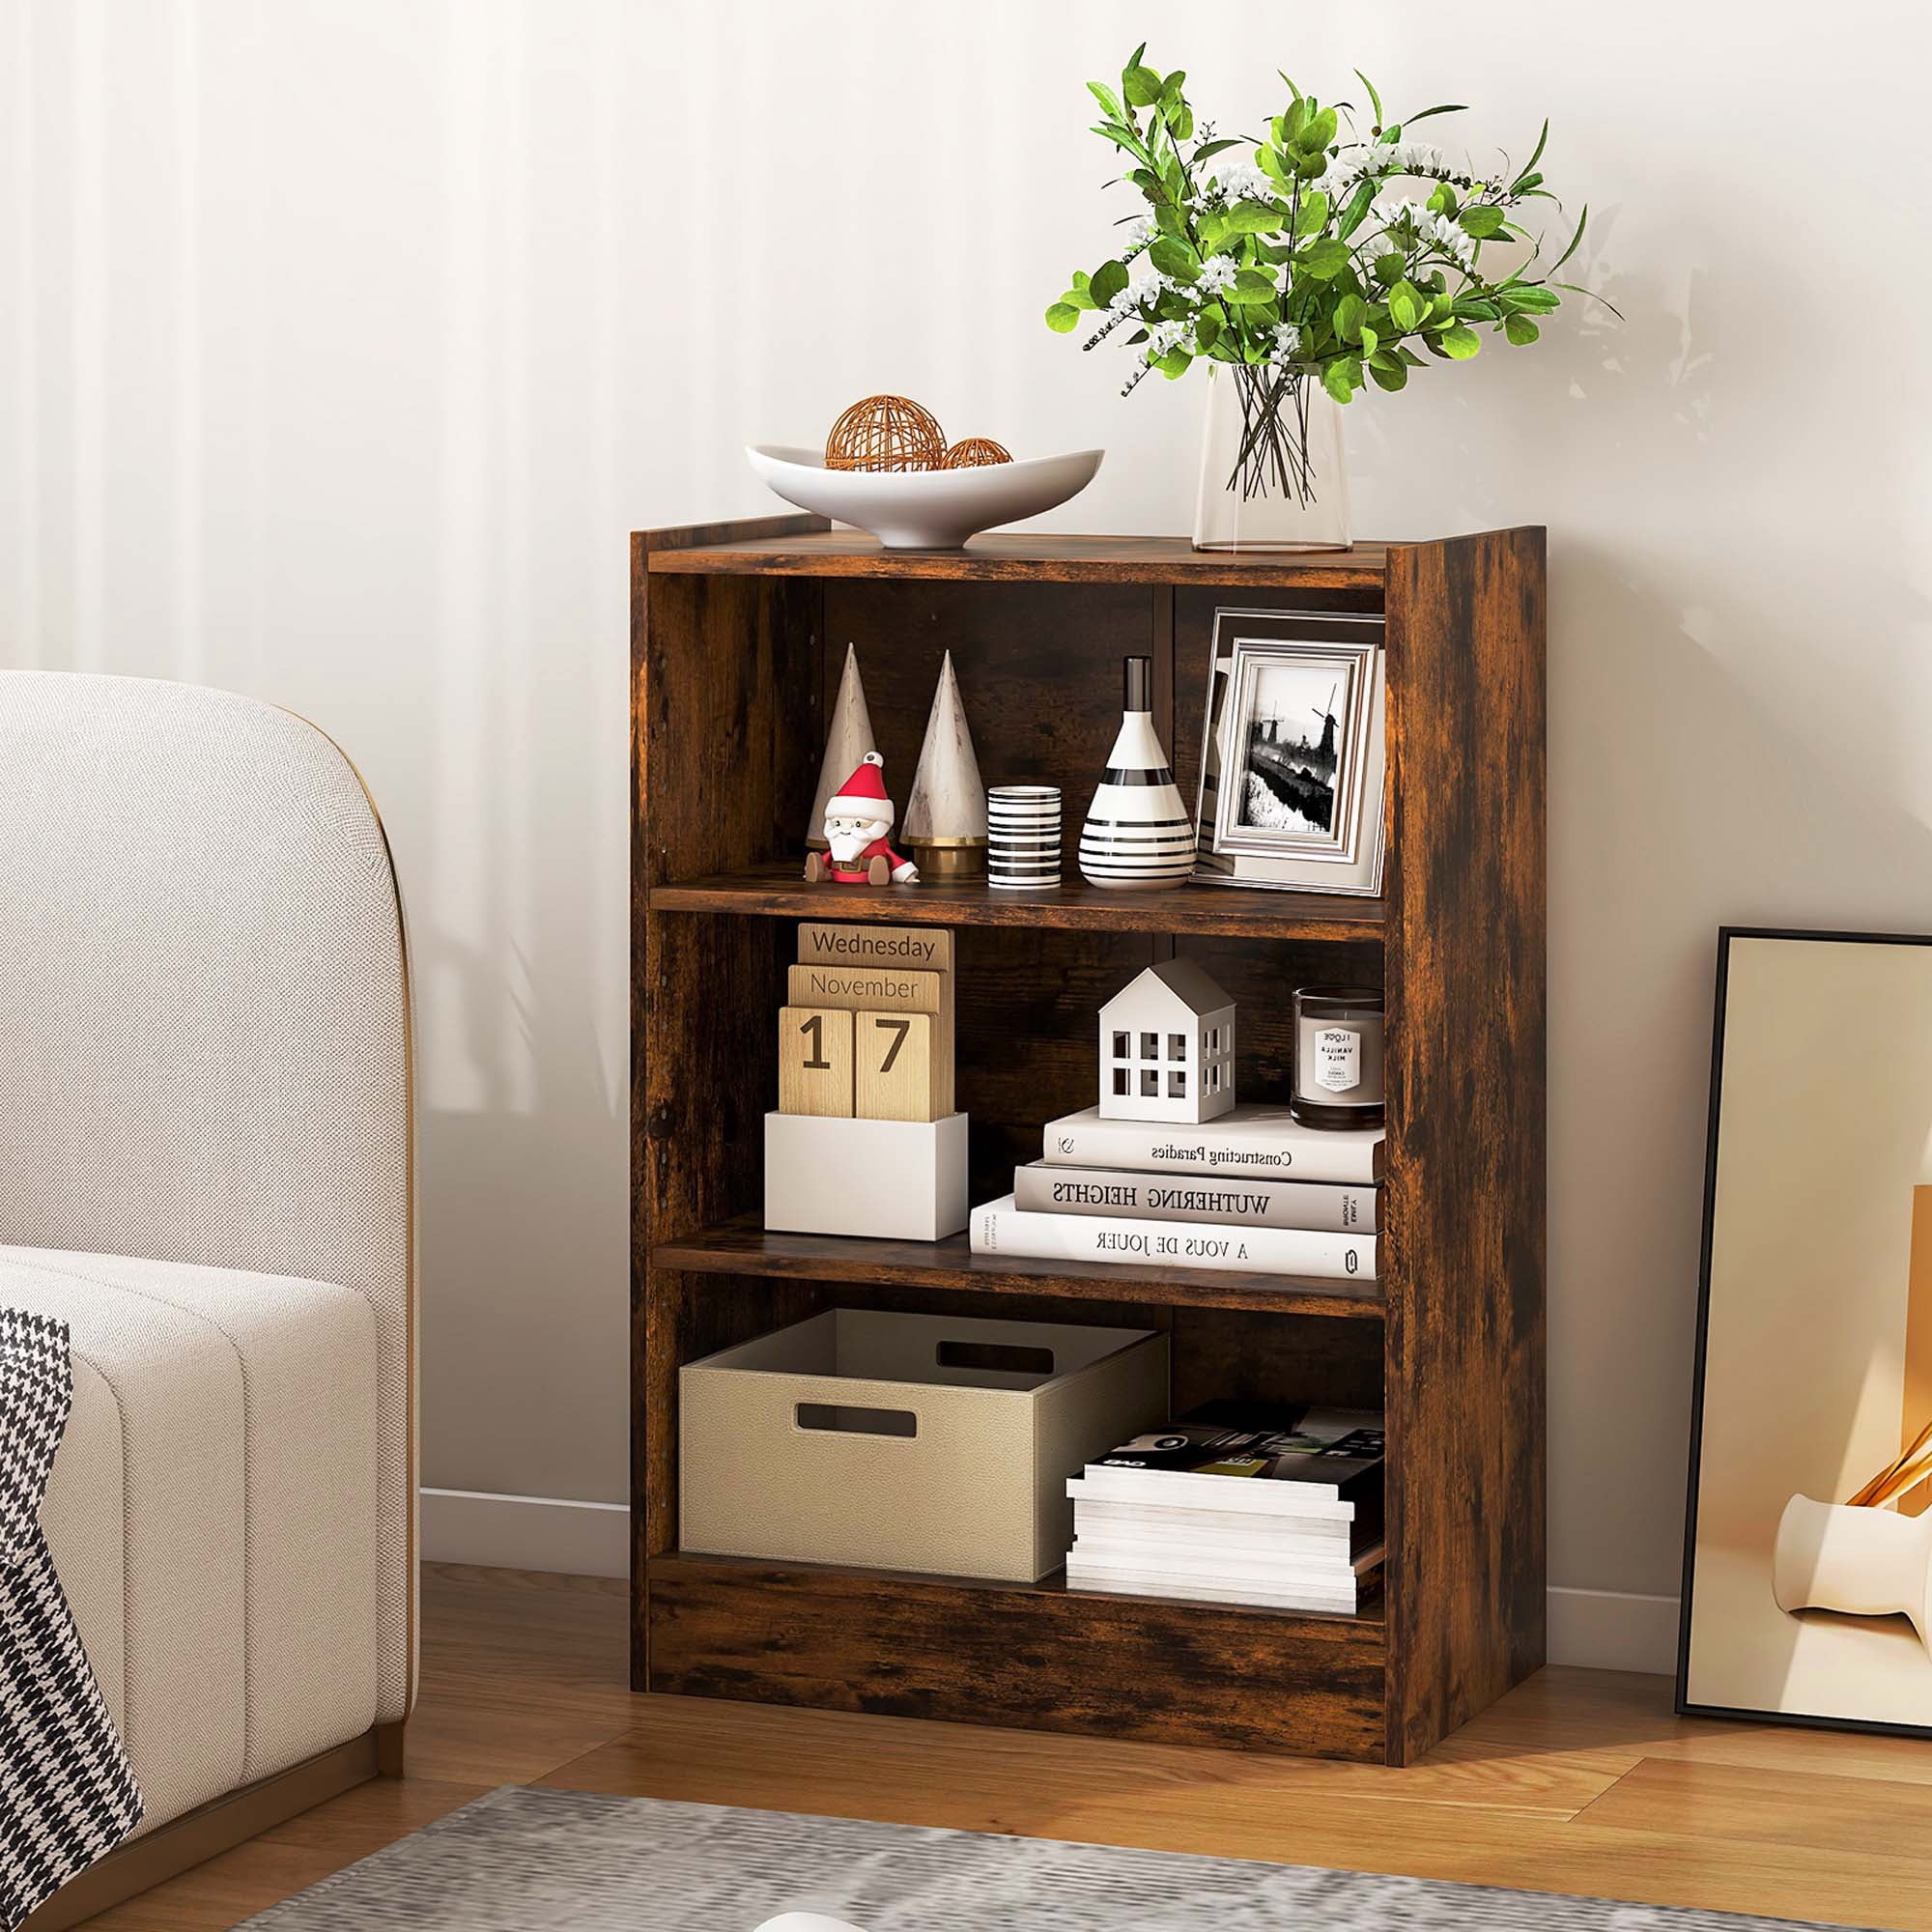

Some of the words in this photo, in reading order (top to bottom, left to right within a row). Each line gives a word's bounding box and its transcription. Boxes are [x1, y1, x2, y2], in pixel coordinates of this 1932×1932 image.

[812, 931, 935, 961] Wednesday
[810, 974, 919, 998] November
[799, 1015, 831, 1069] 1
[875, 1018, 910, 1072] 7
